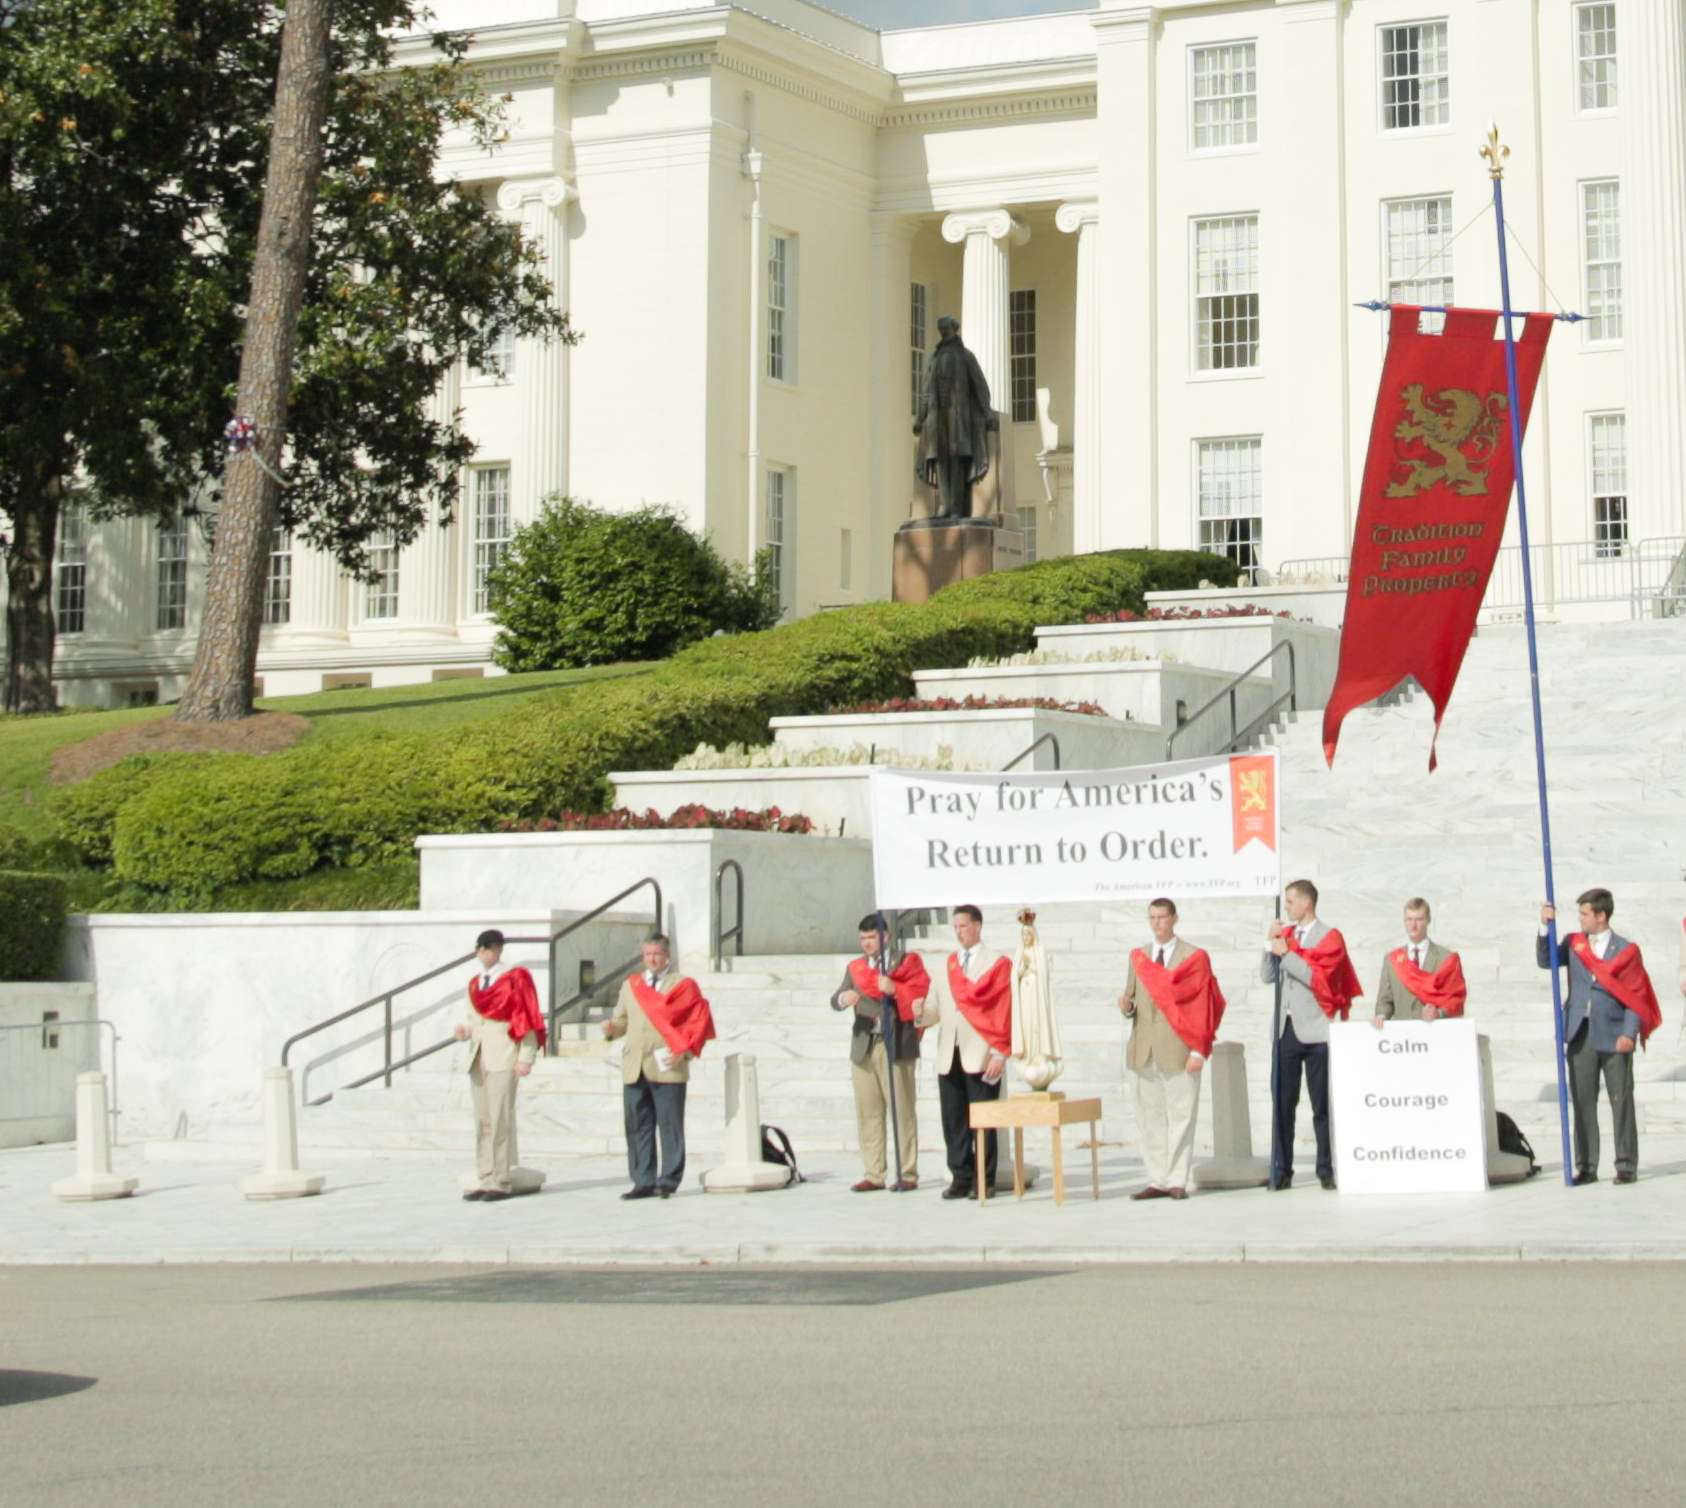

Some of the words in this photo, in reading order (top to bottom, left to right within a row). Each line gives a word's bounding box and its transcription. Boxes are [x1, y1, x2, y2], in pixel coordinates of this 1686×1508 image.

[1372, 523, 1484, 545] Tradition
[1381, 545, 1467, 571] Family
[1361, 567, 1480, 596] Property
[906, 786, 982, 821] Pray
[997, 781, 1044, 811] for
[1054, 772, 1223, 809] America's
[926, 838, 1043, 868] Return
[1057, 835, 1087, 863] to
[1100, 829, 1208, 862] Order.
[1254, 874, 1277, 887] TFP
[1378, 1039, 1429, 1055] Calm
[1364, 1093, 1449, 1110] Courage
[1353, 1146, 1466, 1162] Confidence
